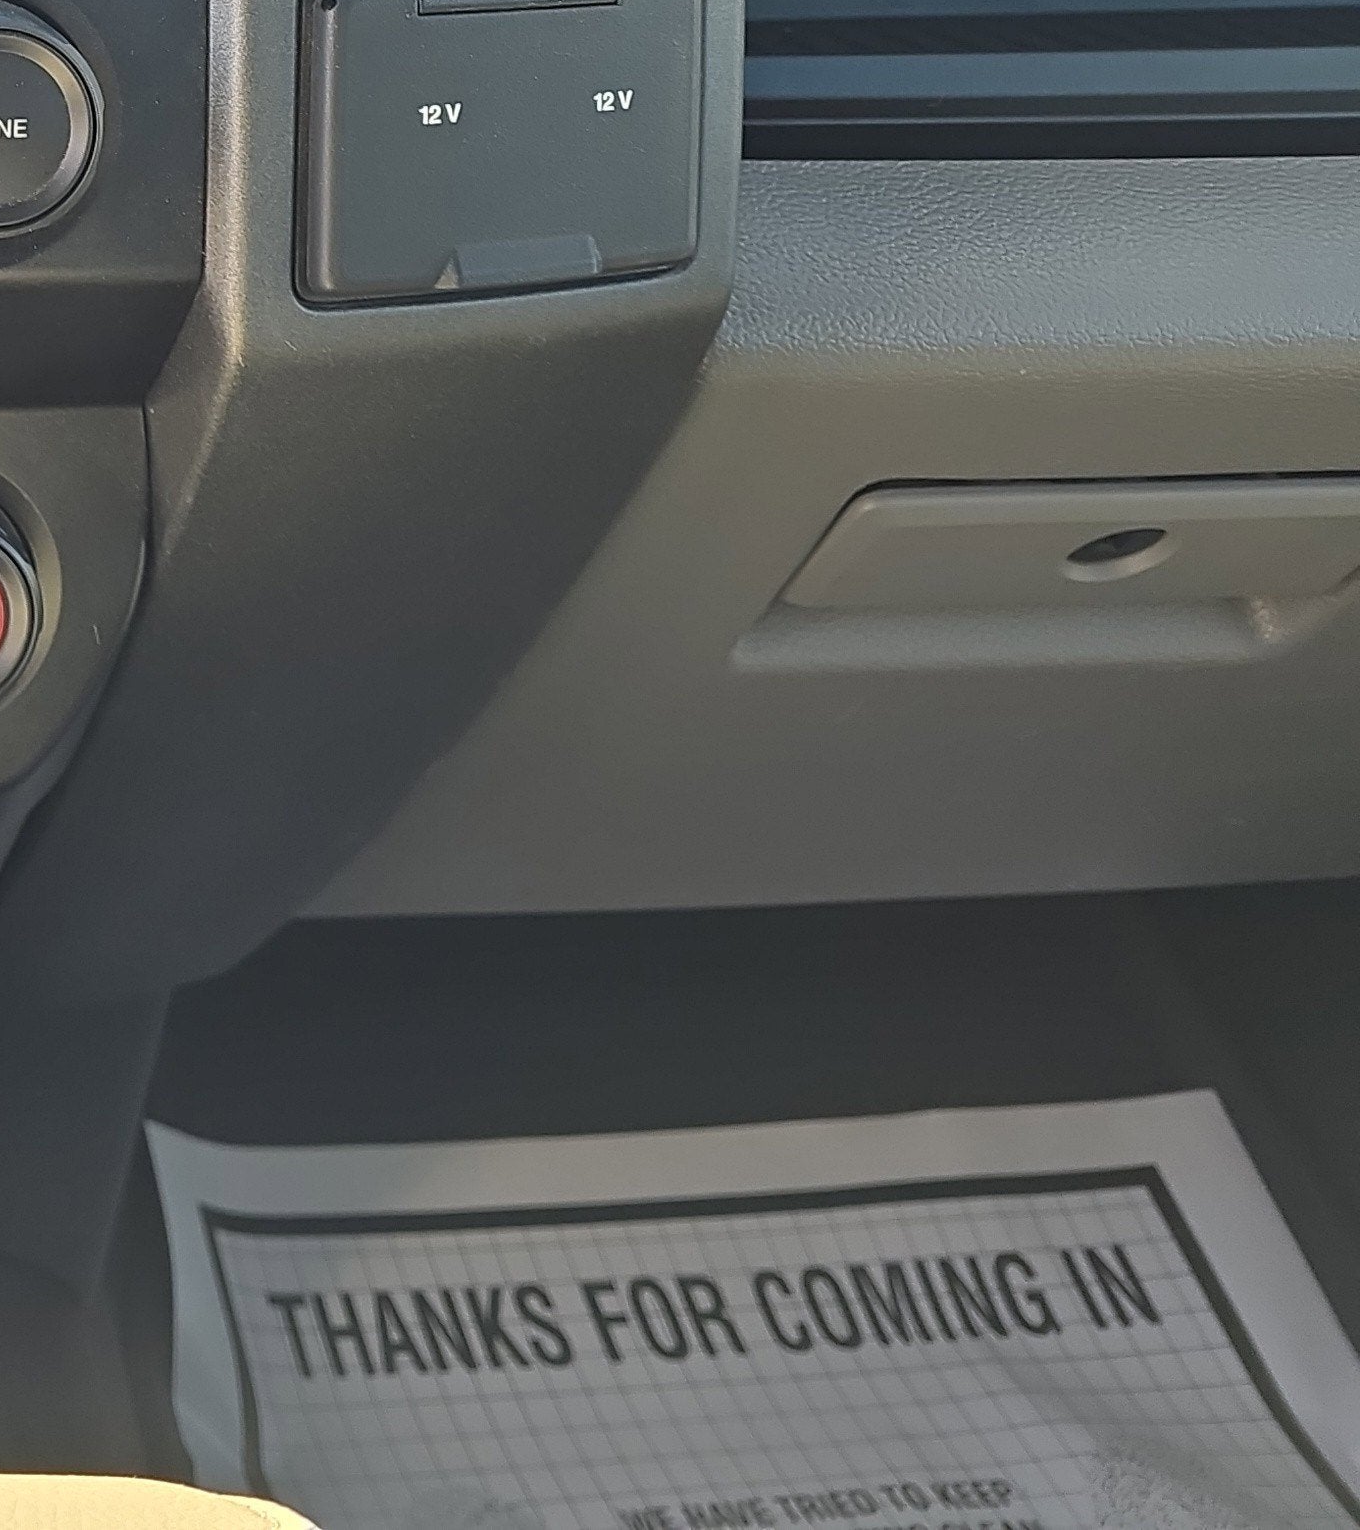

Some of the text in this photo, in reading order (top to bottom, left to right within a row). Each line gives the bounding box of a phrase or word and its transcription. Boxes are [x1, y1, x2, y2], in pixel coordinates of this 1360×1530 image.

[418, 102, 462, 125] 12 V
[593, 89, 634, 112] 12 V
[266, 1243, 1163, 1378] THANKS FOR COMING IN
[682, 1495, 778, 1530] HAVE
[775, 1484, 880, 1525] TRIED
[881, 1479, 931, 1513] TO
[930, 1477, 1013, 1509] KEEP
